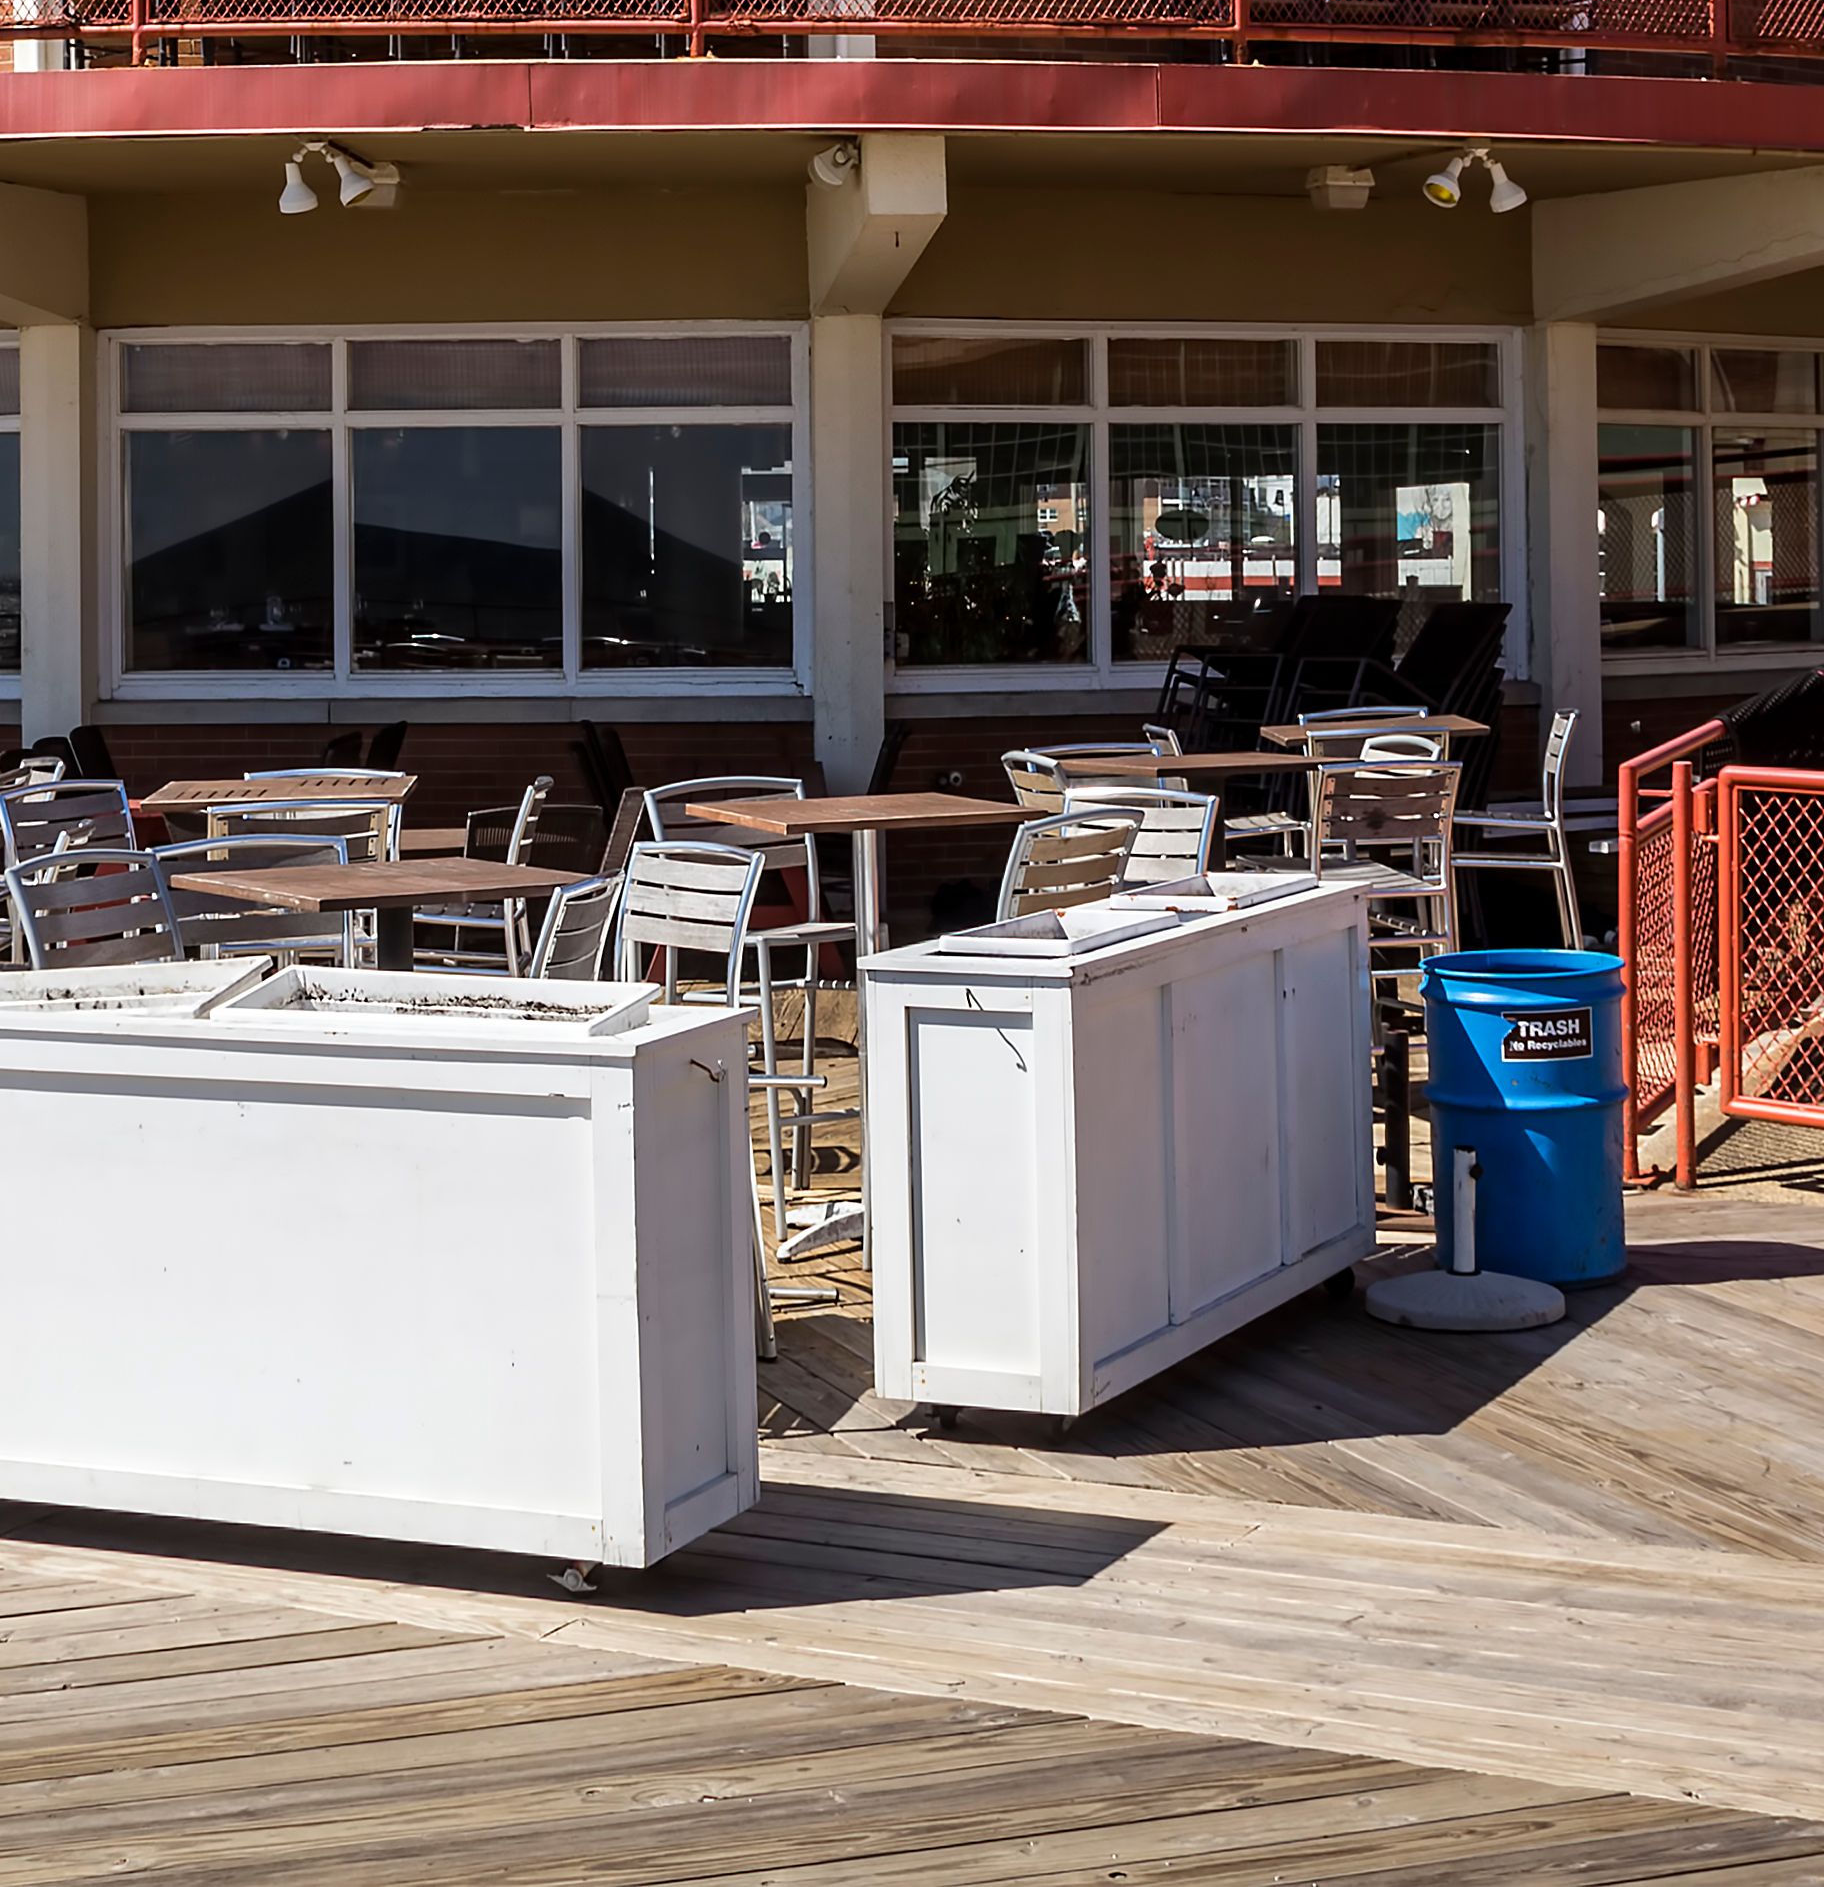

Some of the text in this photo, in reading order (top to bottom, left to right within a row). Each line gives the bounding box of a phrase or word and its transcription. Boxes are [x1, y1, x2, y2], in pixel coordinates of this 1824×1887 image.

[1517, 1018, 1580, 1038] TRASH
[1509, 1038, 1587, 1051] No Recyclables
